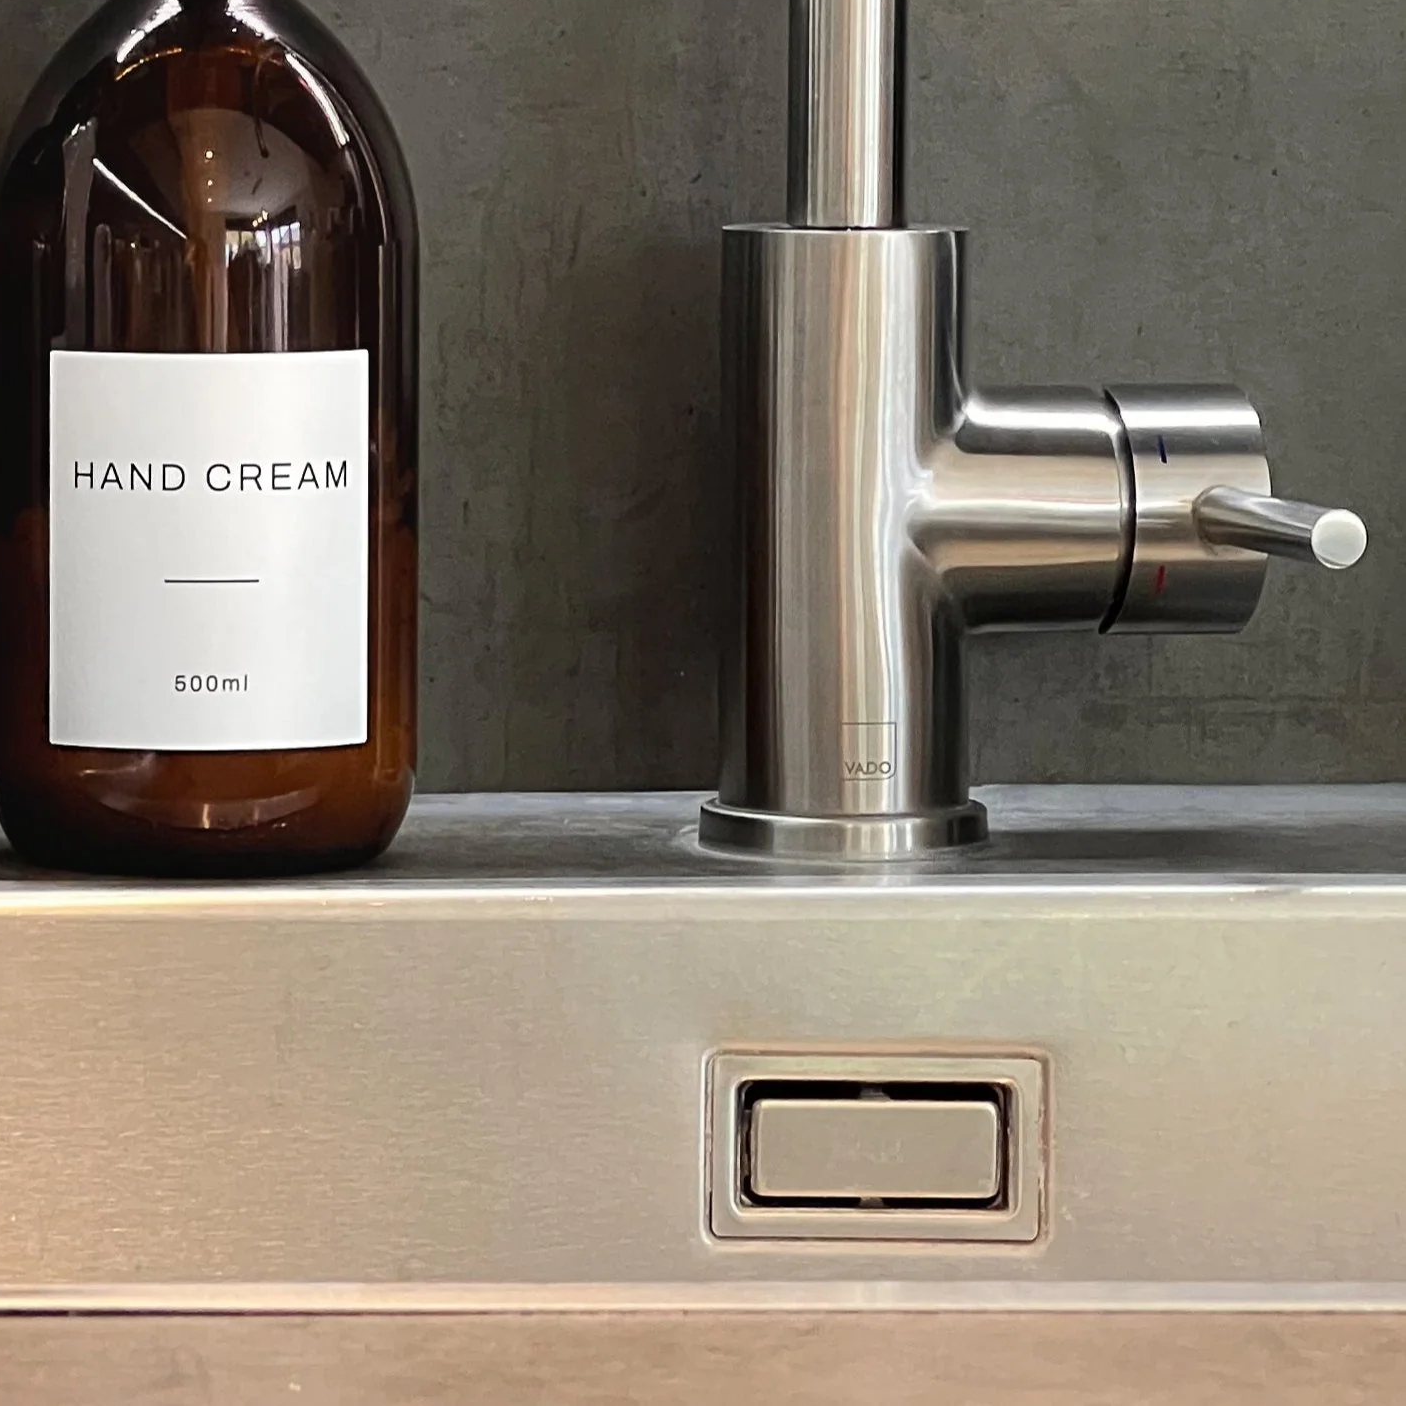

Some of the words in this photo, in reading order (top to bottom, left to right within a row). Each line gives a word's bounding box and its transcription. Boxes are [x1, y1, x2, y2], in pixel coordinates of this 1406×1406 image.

[74, 461, 186, 491] HAND
[206, 460, 347, 492] CREAM
[174, 674, 248, 693] 500ml
[844, 761, 892, 775] VADO
